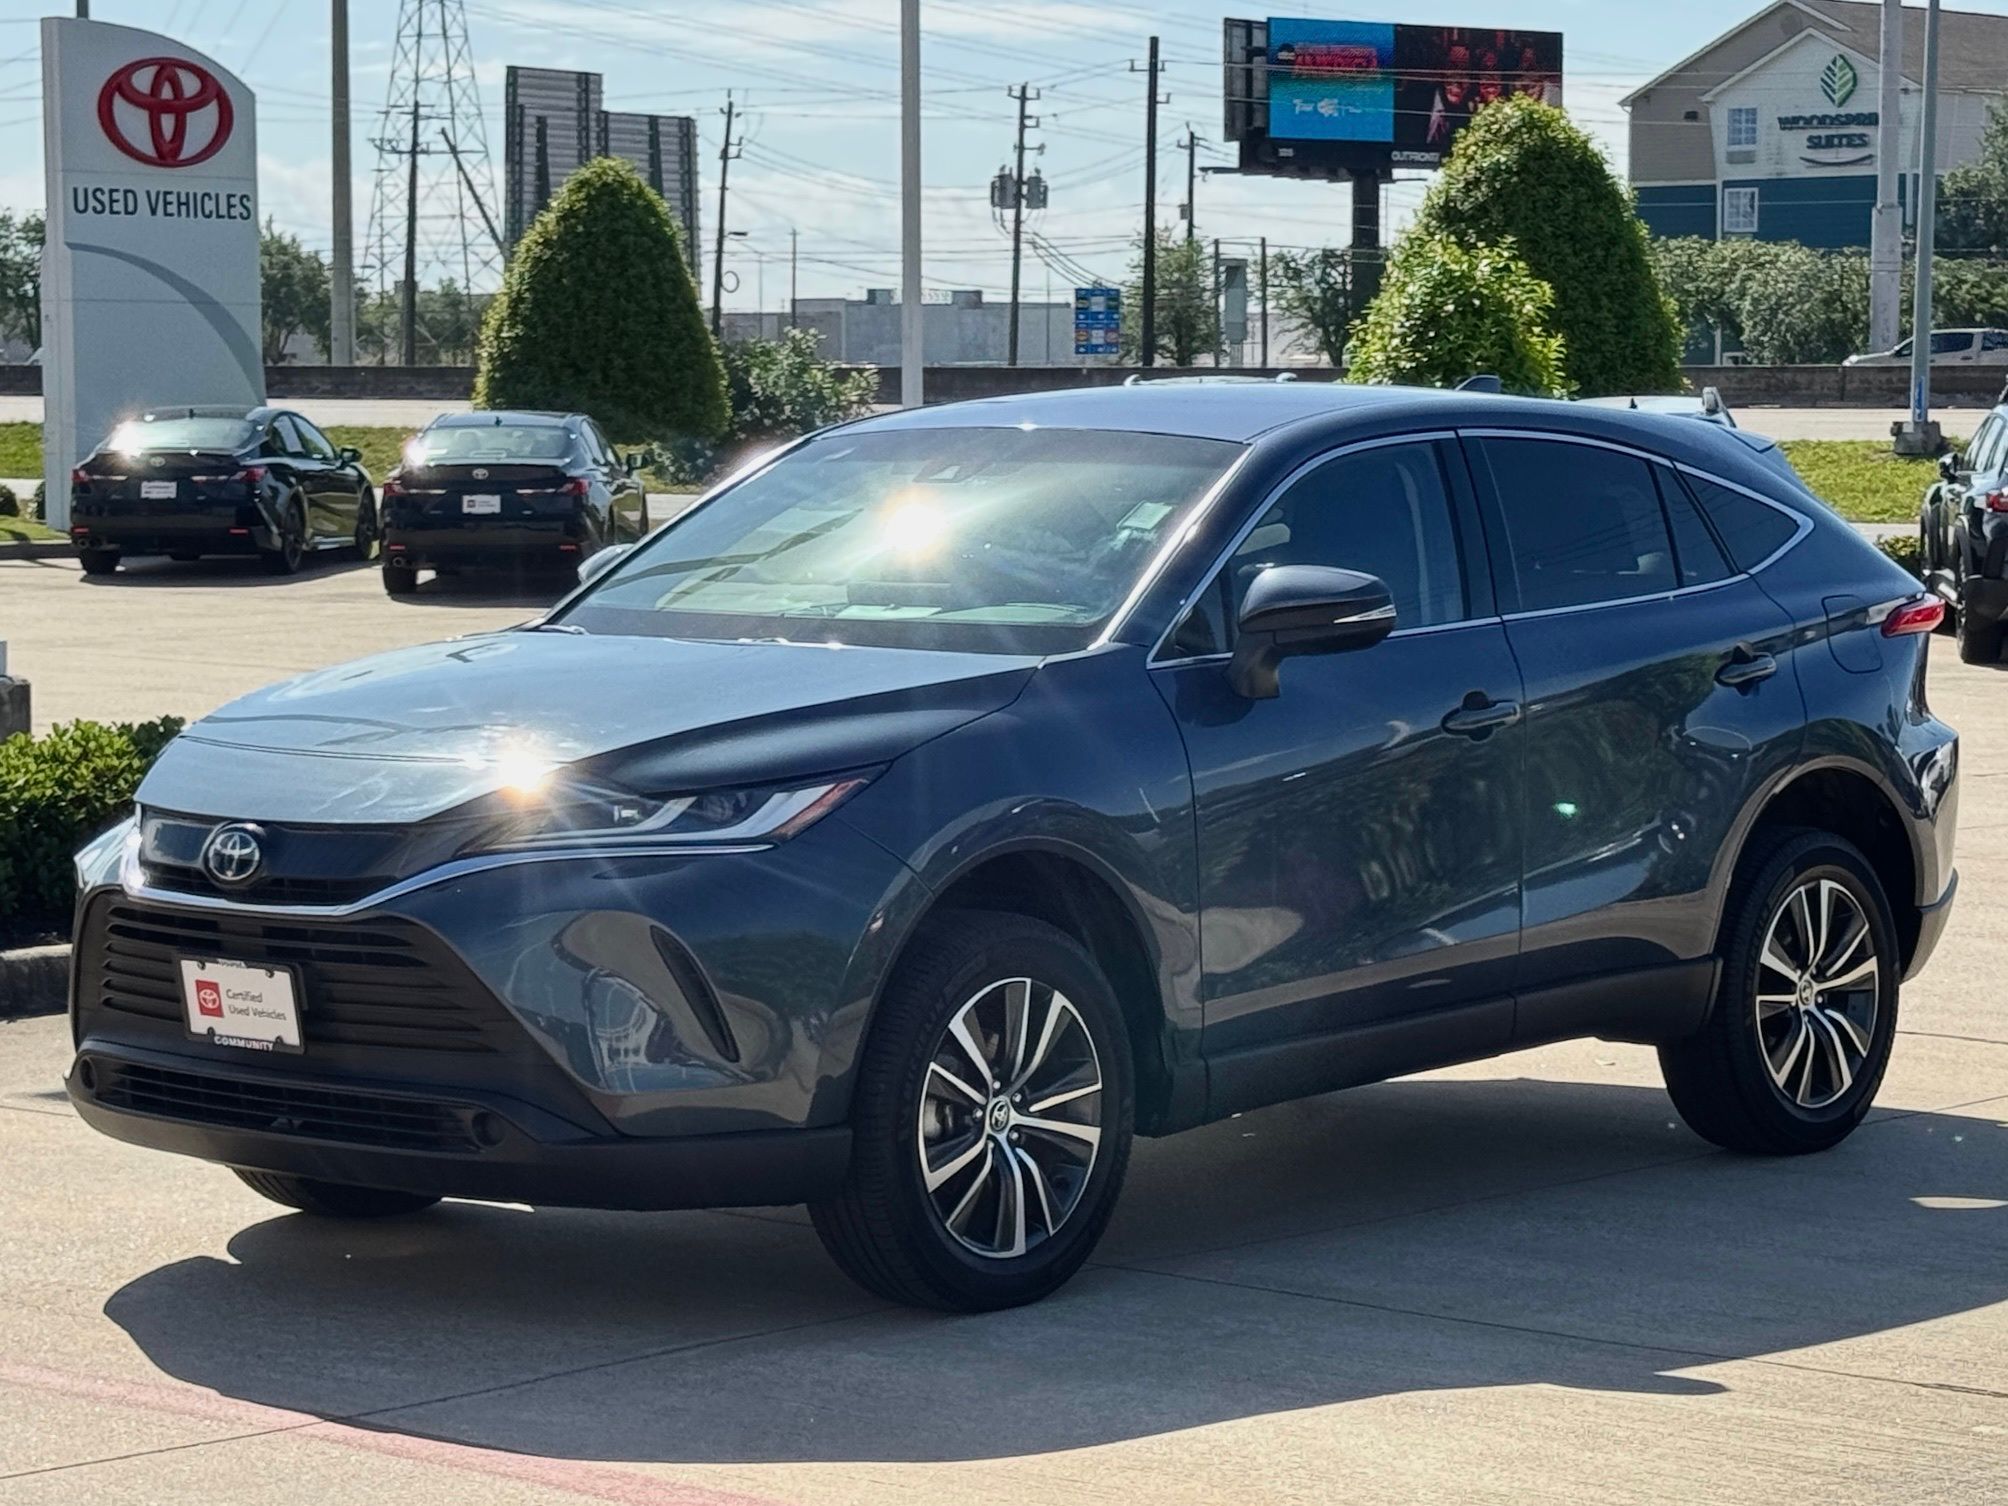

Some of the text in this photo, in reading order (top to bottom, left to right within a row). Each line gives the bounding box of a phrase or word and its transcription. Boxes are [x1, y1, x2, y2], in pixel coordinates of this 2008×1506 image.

[1806, 133, 1869, 149] SUITES
[72, 186, 252, 221] USED VEHICLES
[225, 988, 263, 1003] Certified
[228, 1004, 287, 1021] Used Vehicles
[213, 1035, 274, 1052] COMMUNITY
